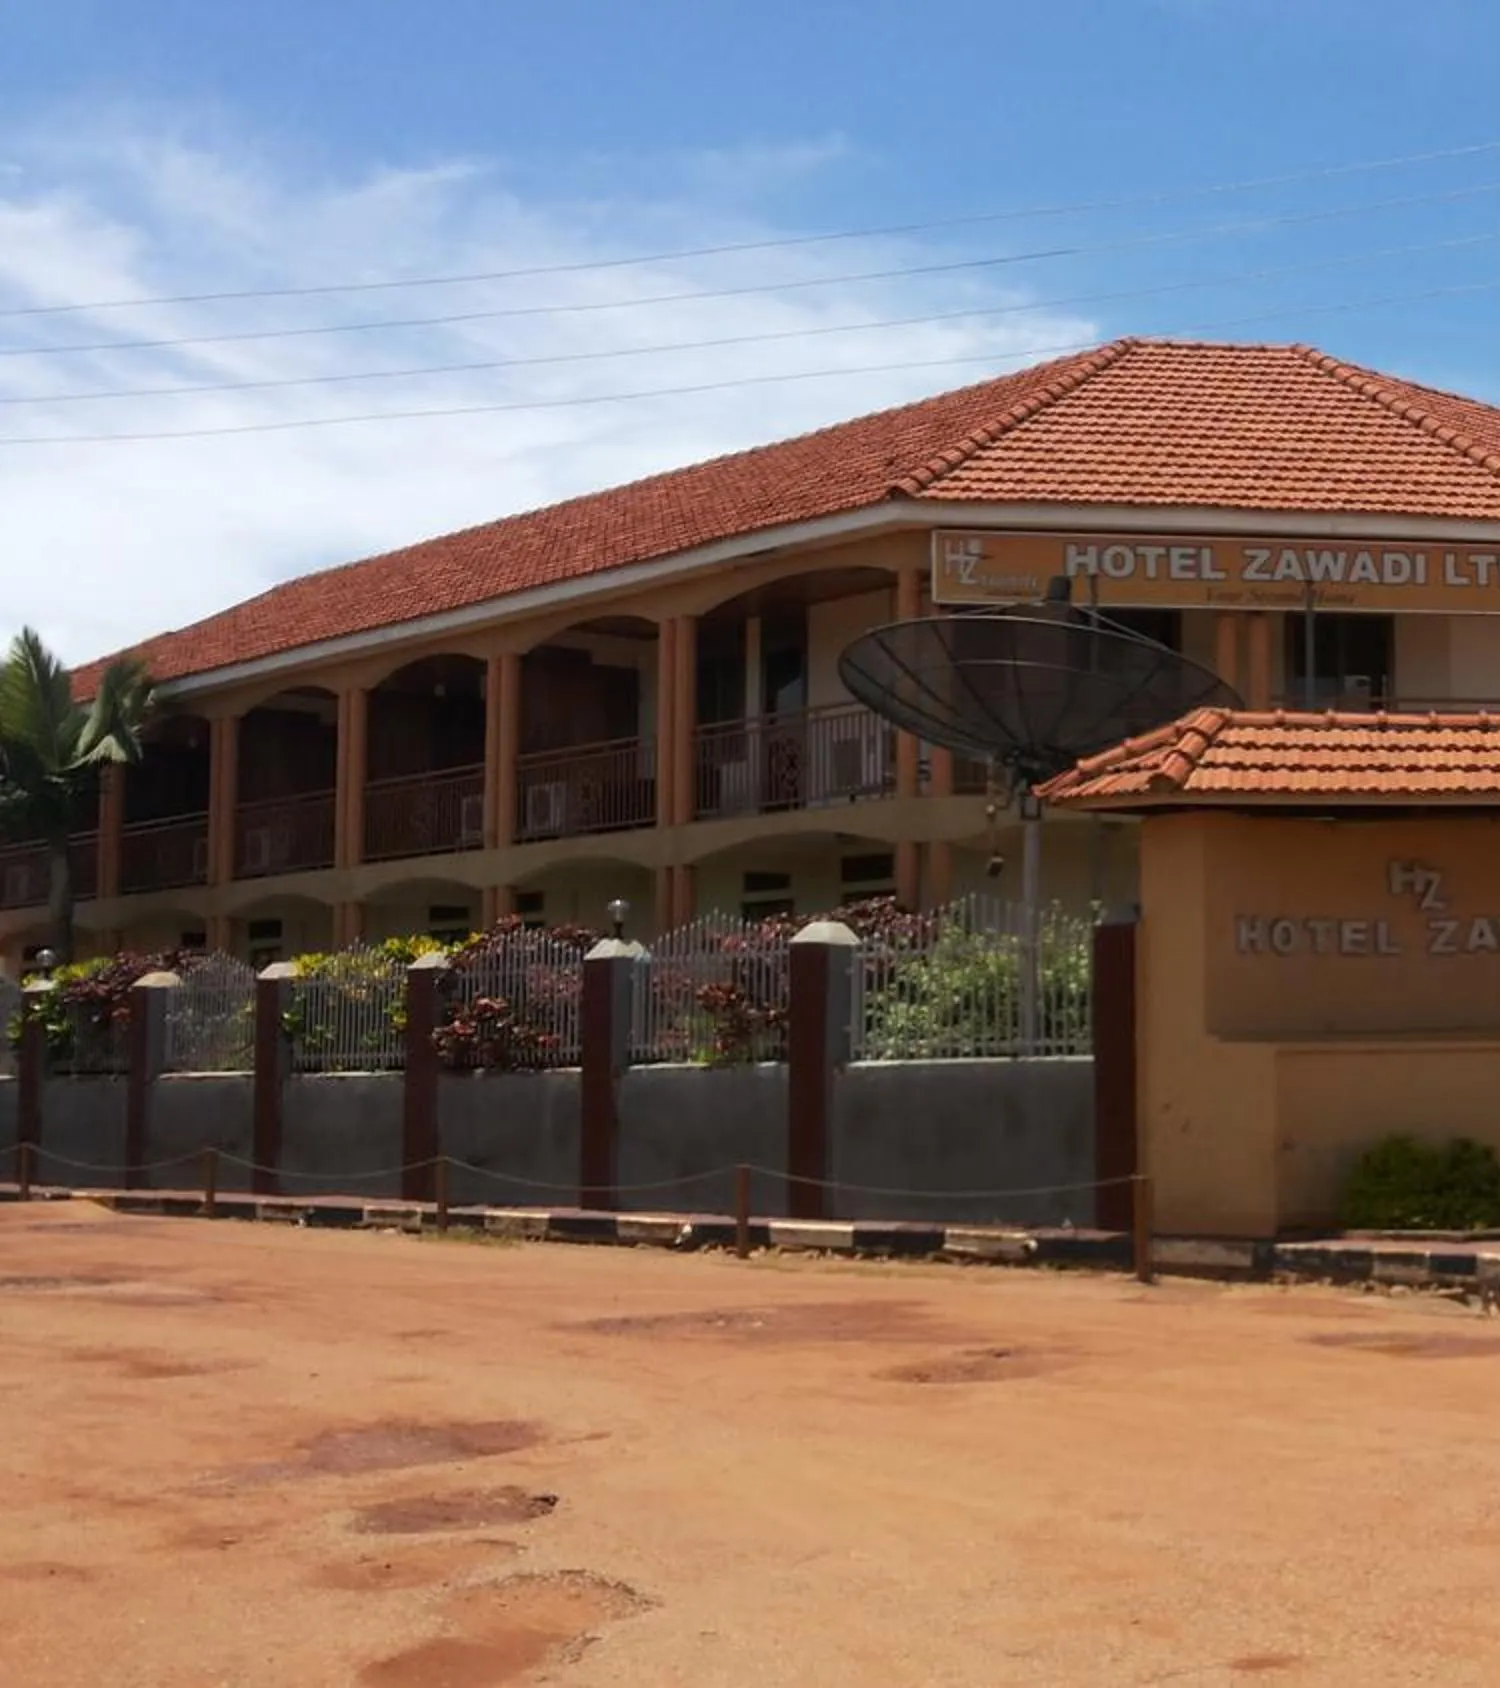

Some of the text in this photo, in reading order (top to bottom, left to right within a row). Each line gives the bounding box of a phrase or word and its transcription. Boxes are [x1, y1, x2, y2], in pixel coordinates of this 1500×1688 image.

[1064, 544, 1226, 581] HOTEL
[1242, 547, 1426, 585] ZAWADI
[1235, 916, 1402, 956] HOTEL
